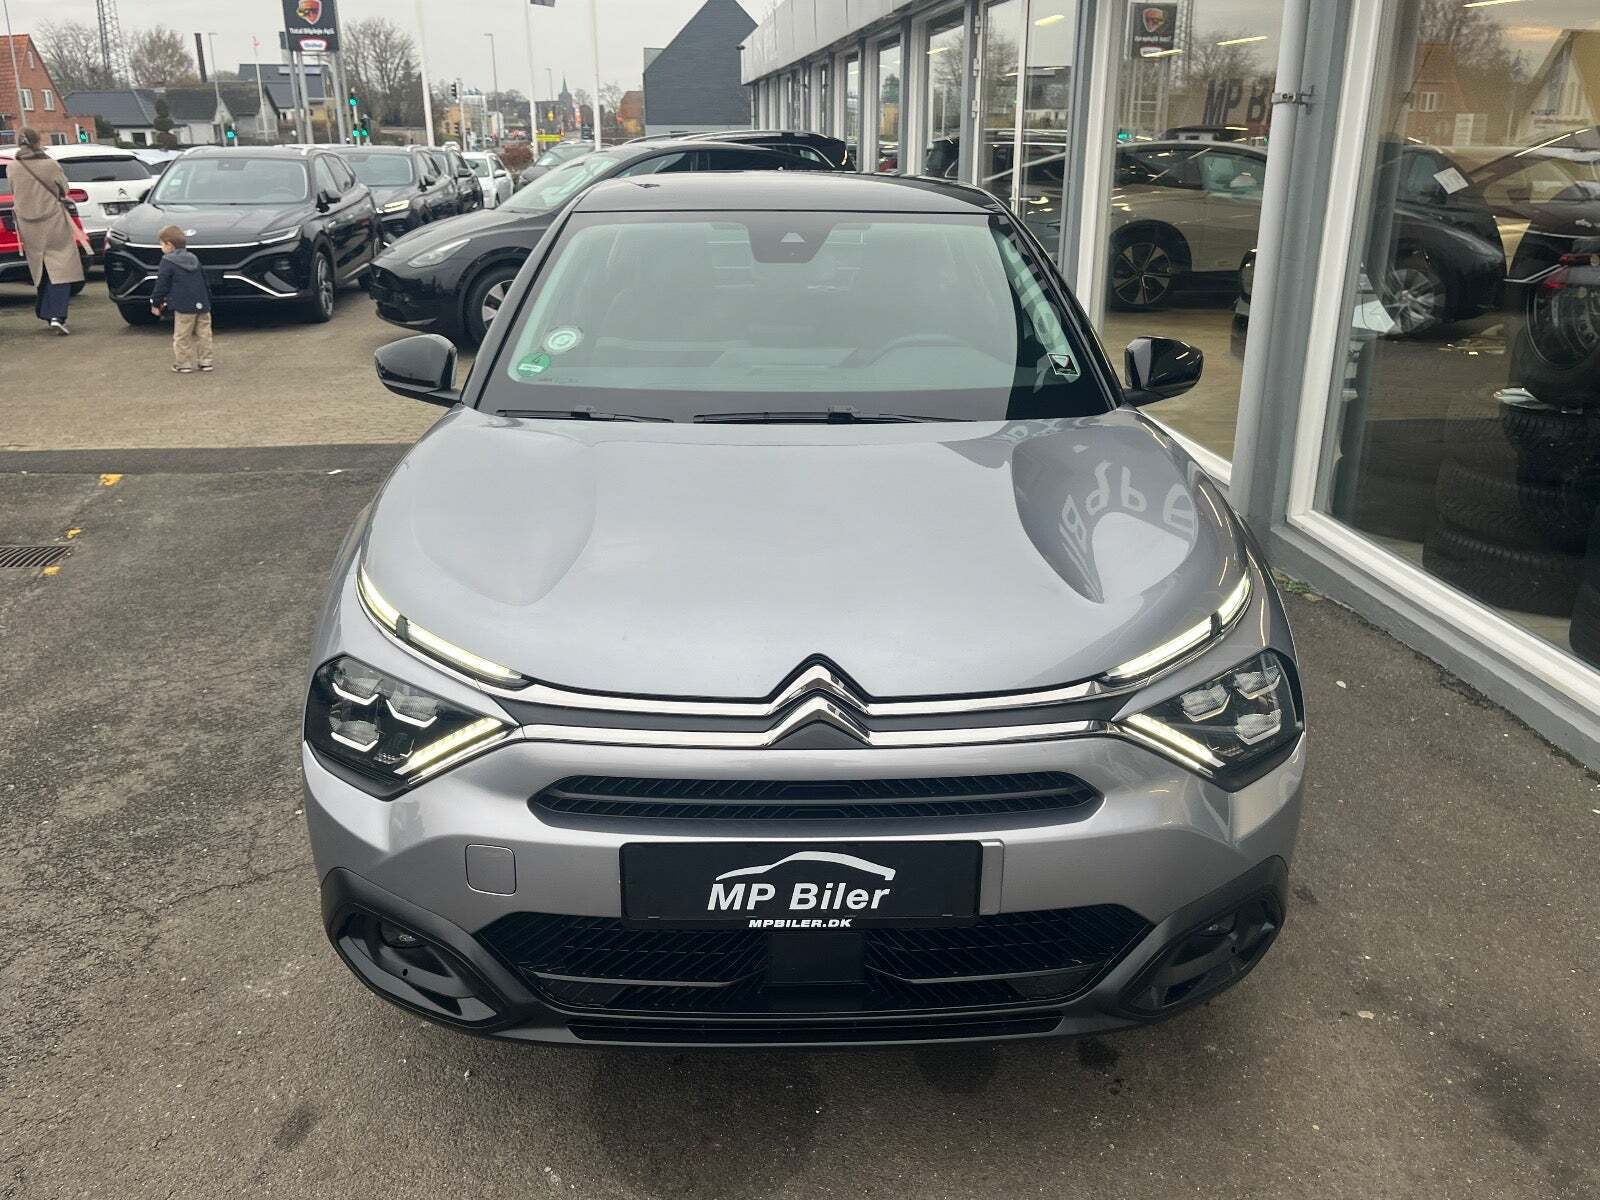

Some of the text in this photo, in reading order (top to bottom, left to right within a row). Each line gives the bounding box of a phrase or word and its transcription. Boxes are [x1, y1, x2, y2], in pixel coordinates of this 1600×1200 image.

[707, 882, 891, 911] MP Biler
[748, 918, 853, 928] MPBILER.DK
